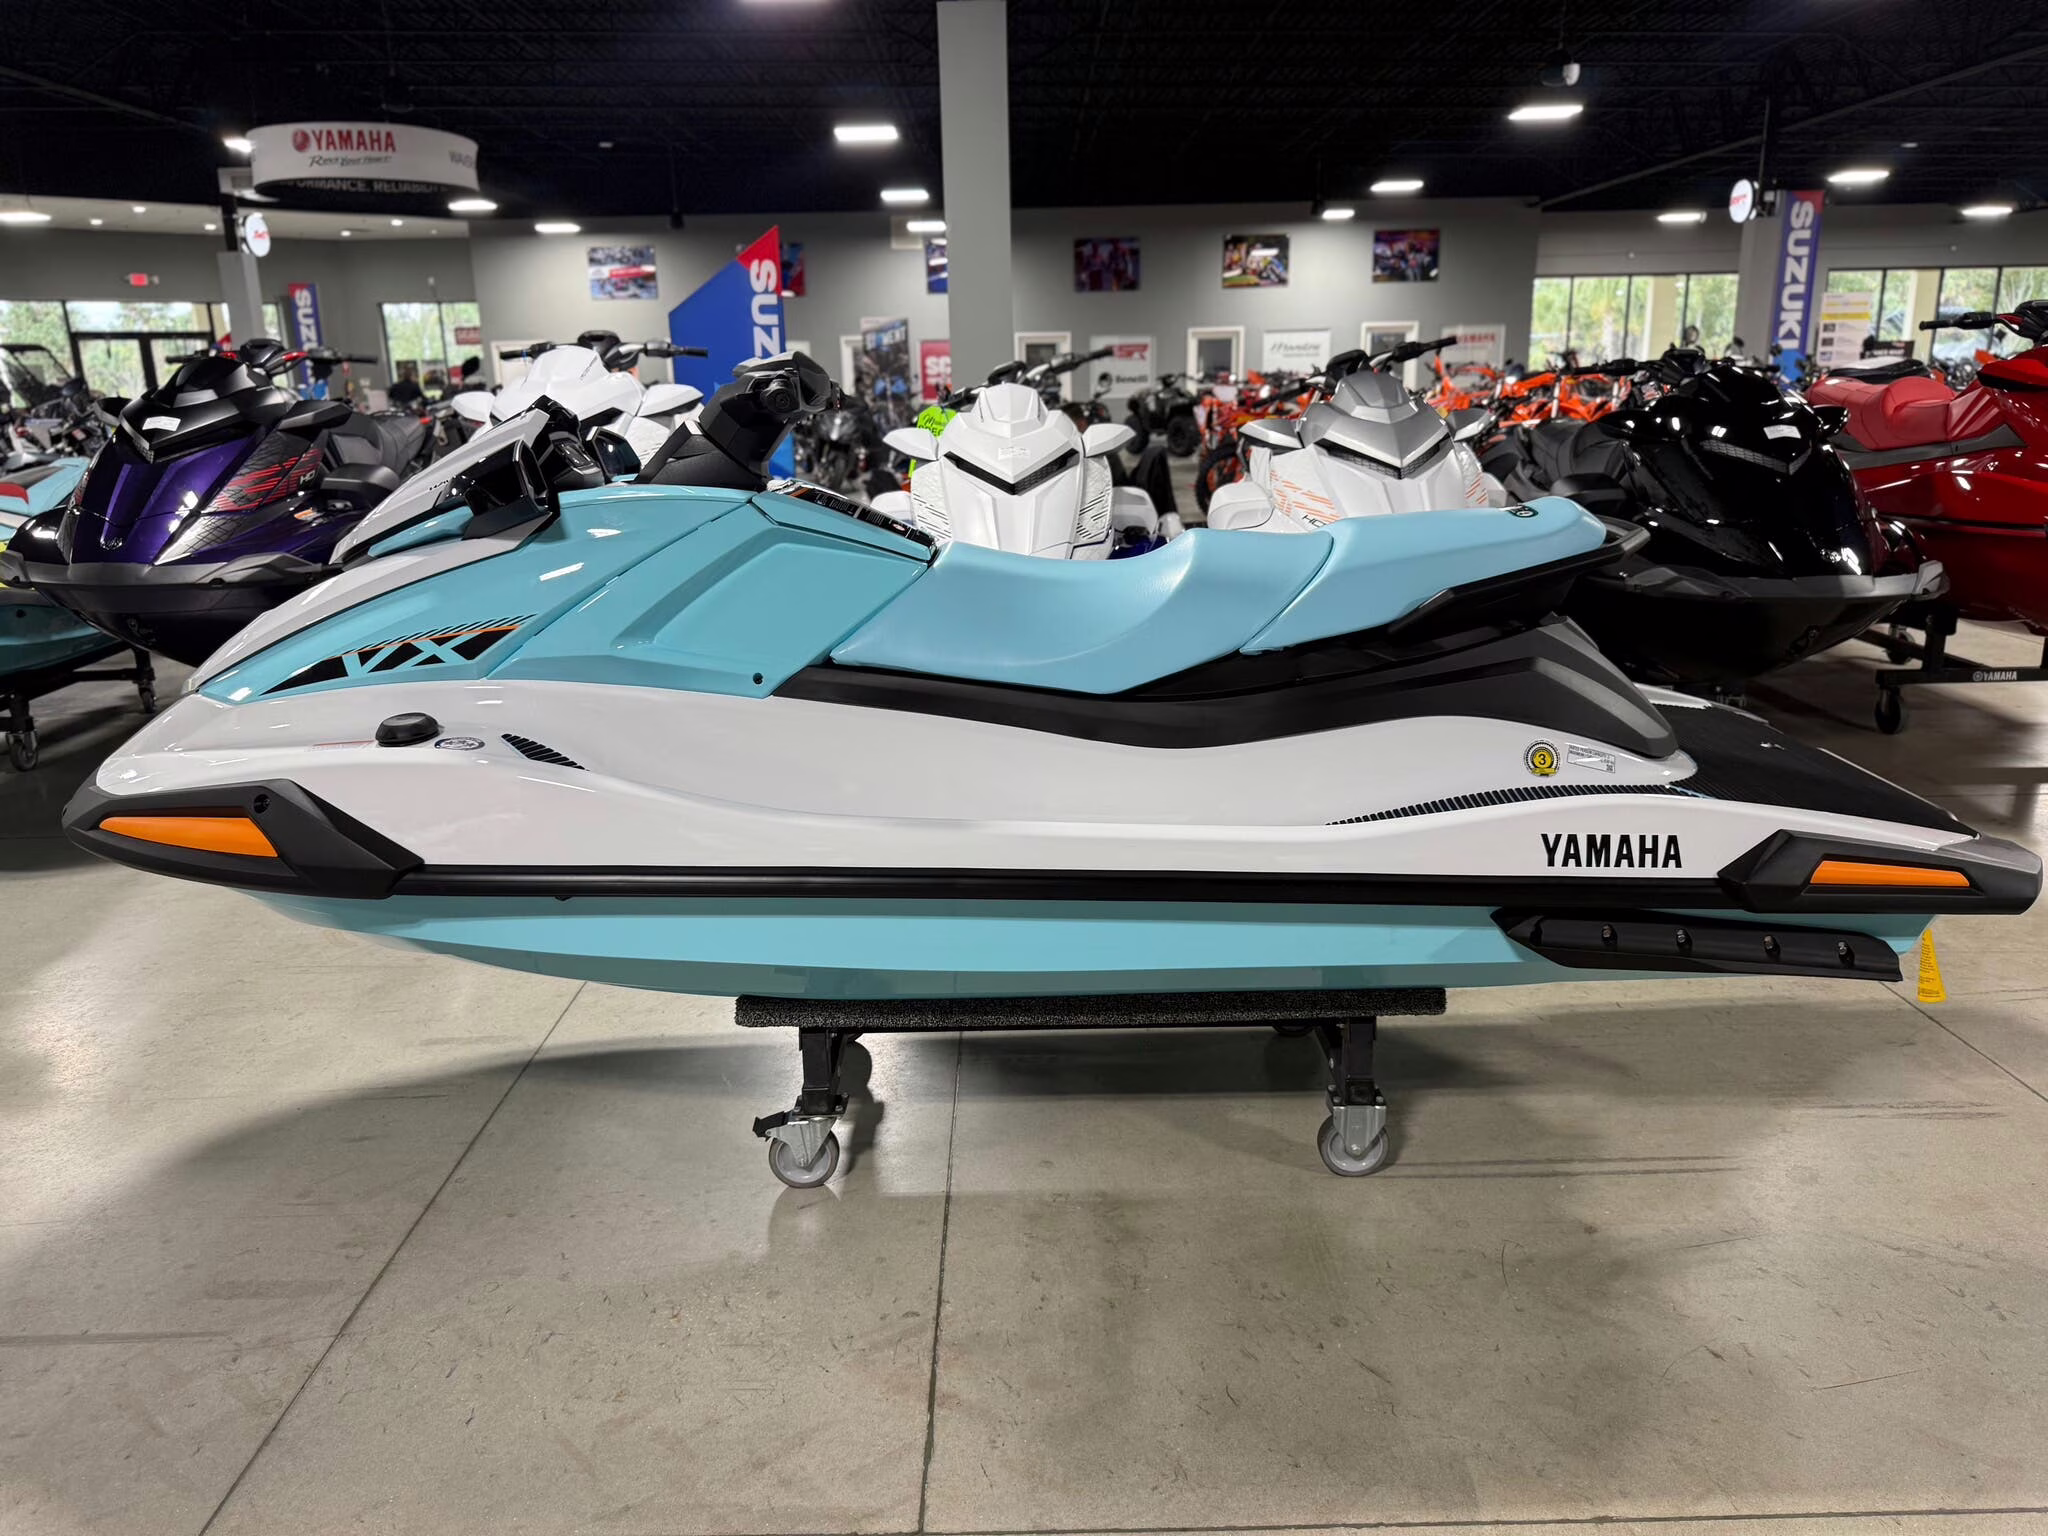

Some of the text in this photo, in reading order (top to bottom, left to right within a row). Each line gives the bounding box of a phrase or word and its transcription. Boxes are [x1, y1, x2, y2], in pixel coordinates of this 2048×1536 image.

[310, 129, 396, 152] YAMAHA
[1777, 200, 1815, 350] SUZUKI
[750, 258, 780, 359] SUZ
[1983, 671, 2018, 681] YAMAHA
[1538, 753, 1546, 766] 3
[1541, 833, 1683, 869] YAMAHA
